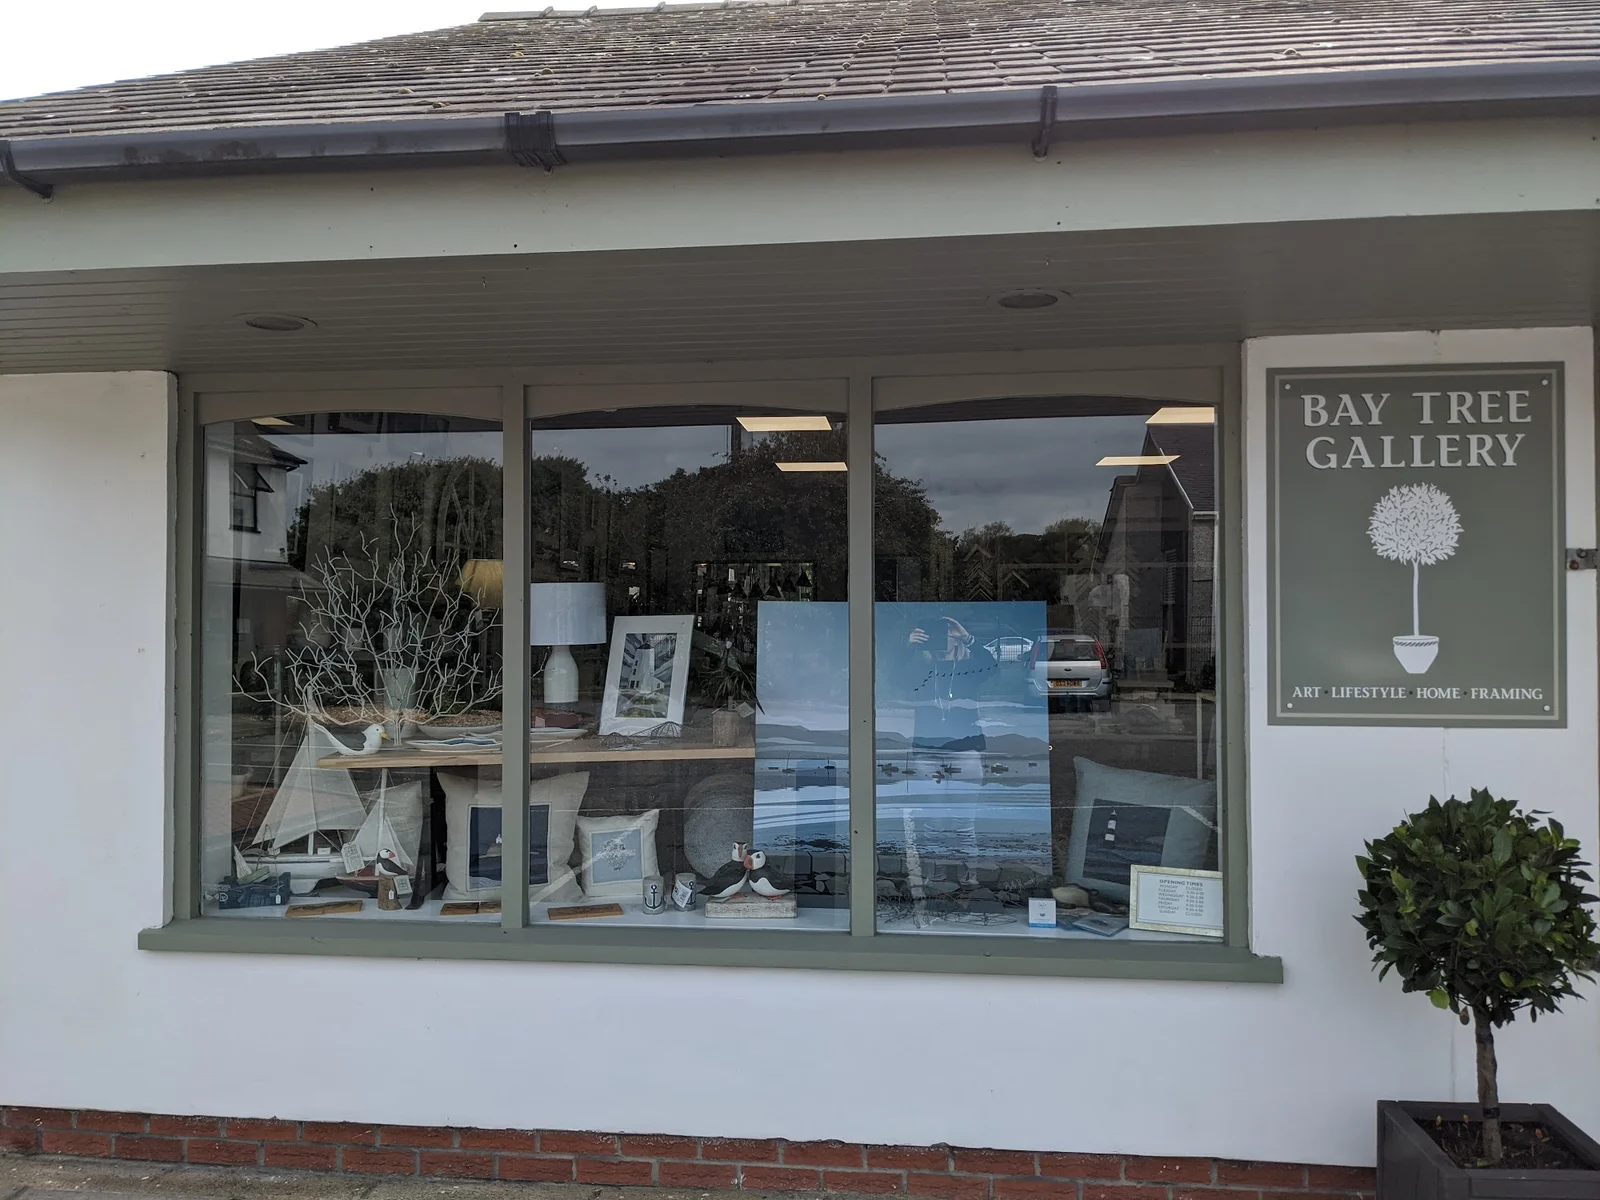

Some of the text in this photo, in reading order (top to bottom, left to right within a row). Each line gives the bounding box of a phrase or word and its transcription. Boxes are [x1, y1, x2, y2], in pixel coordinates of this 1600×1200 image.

[1300, 390, 1532, 427] BAY TREE
[1305, 433, 1526, 470] GALLERY
[1292, 686, 1543, 700] ART LIFESTYLE HOME FRAMING
